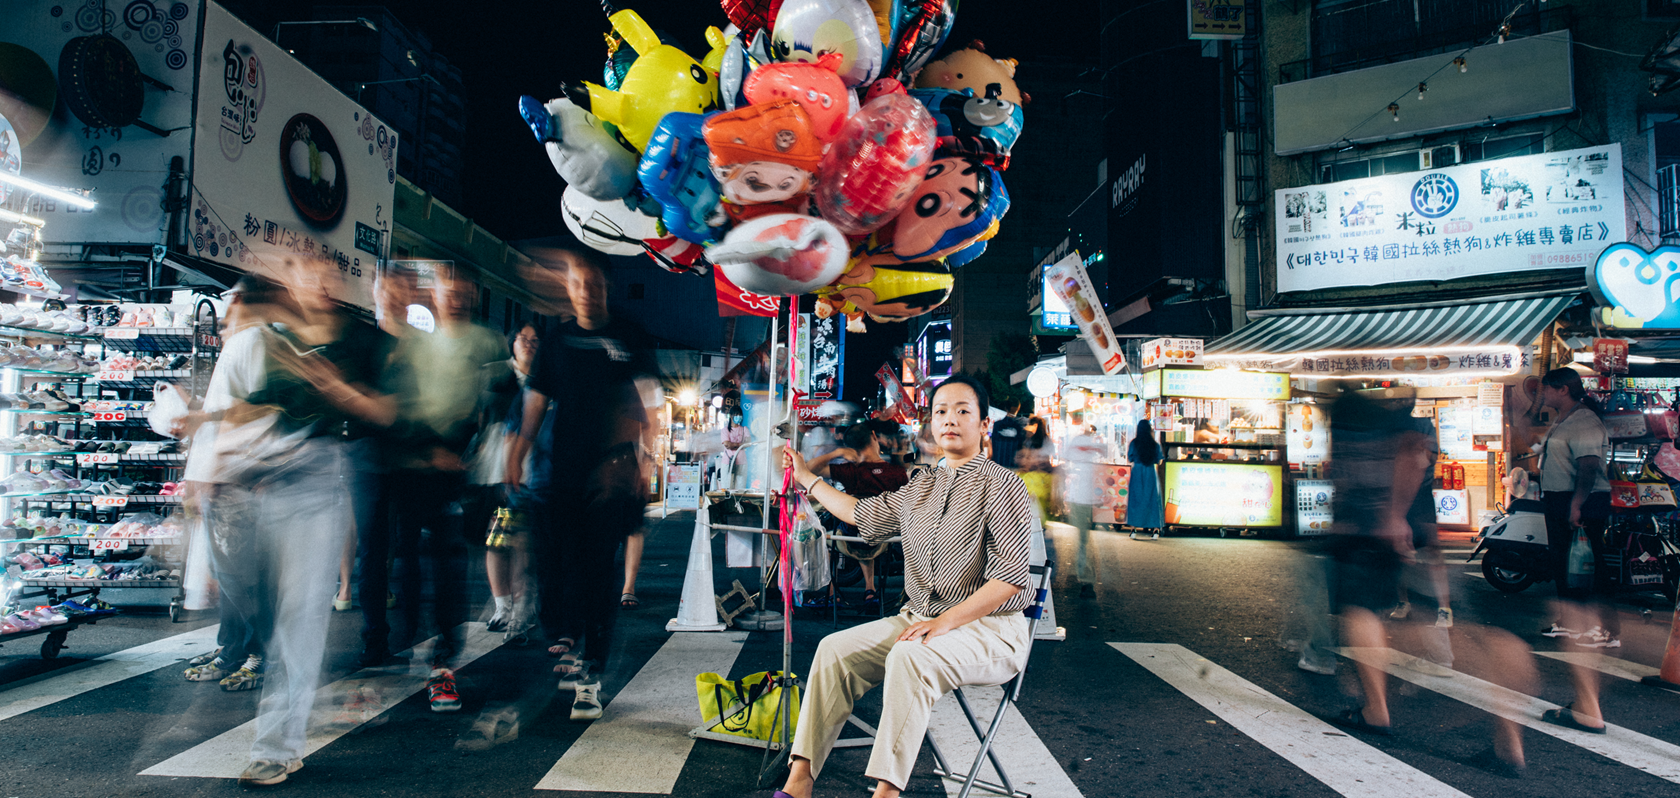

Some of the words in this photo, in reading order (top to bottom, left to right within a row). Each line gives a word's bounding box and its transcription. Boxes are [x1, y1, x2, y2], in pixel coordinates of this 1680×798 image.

[1112, 152, 1146, 209] RAYRAY
[1395, 211, 1437, 237] 米粒
[205, 335, 220, 347] 200
[1301, 356, 1391, 373] 韓國拉絲熱狗
[100, 371, 125, 380] 200
[83, 454, 109, 463] 200
[95, 540, 121, 549] 200
